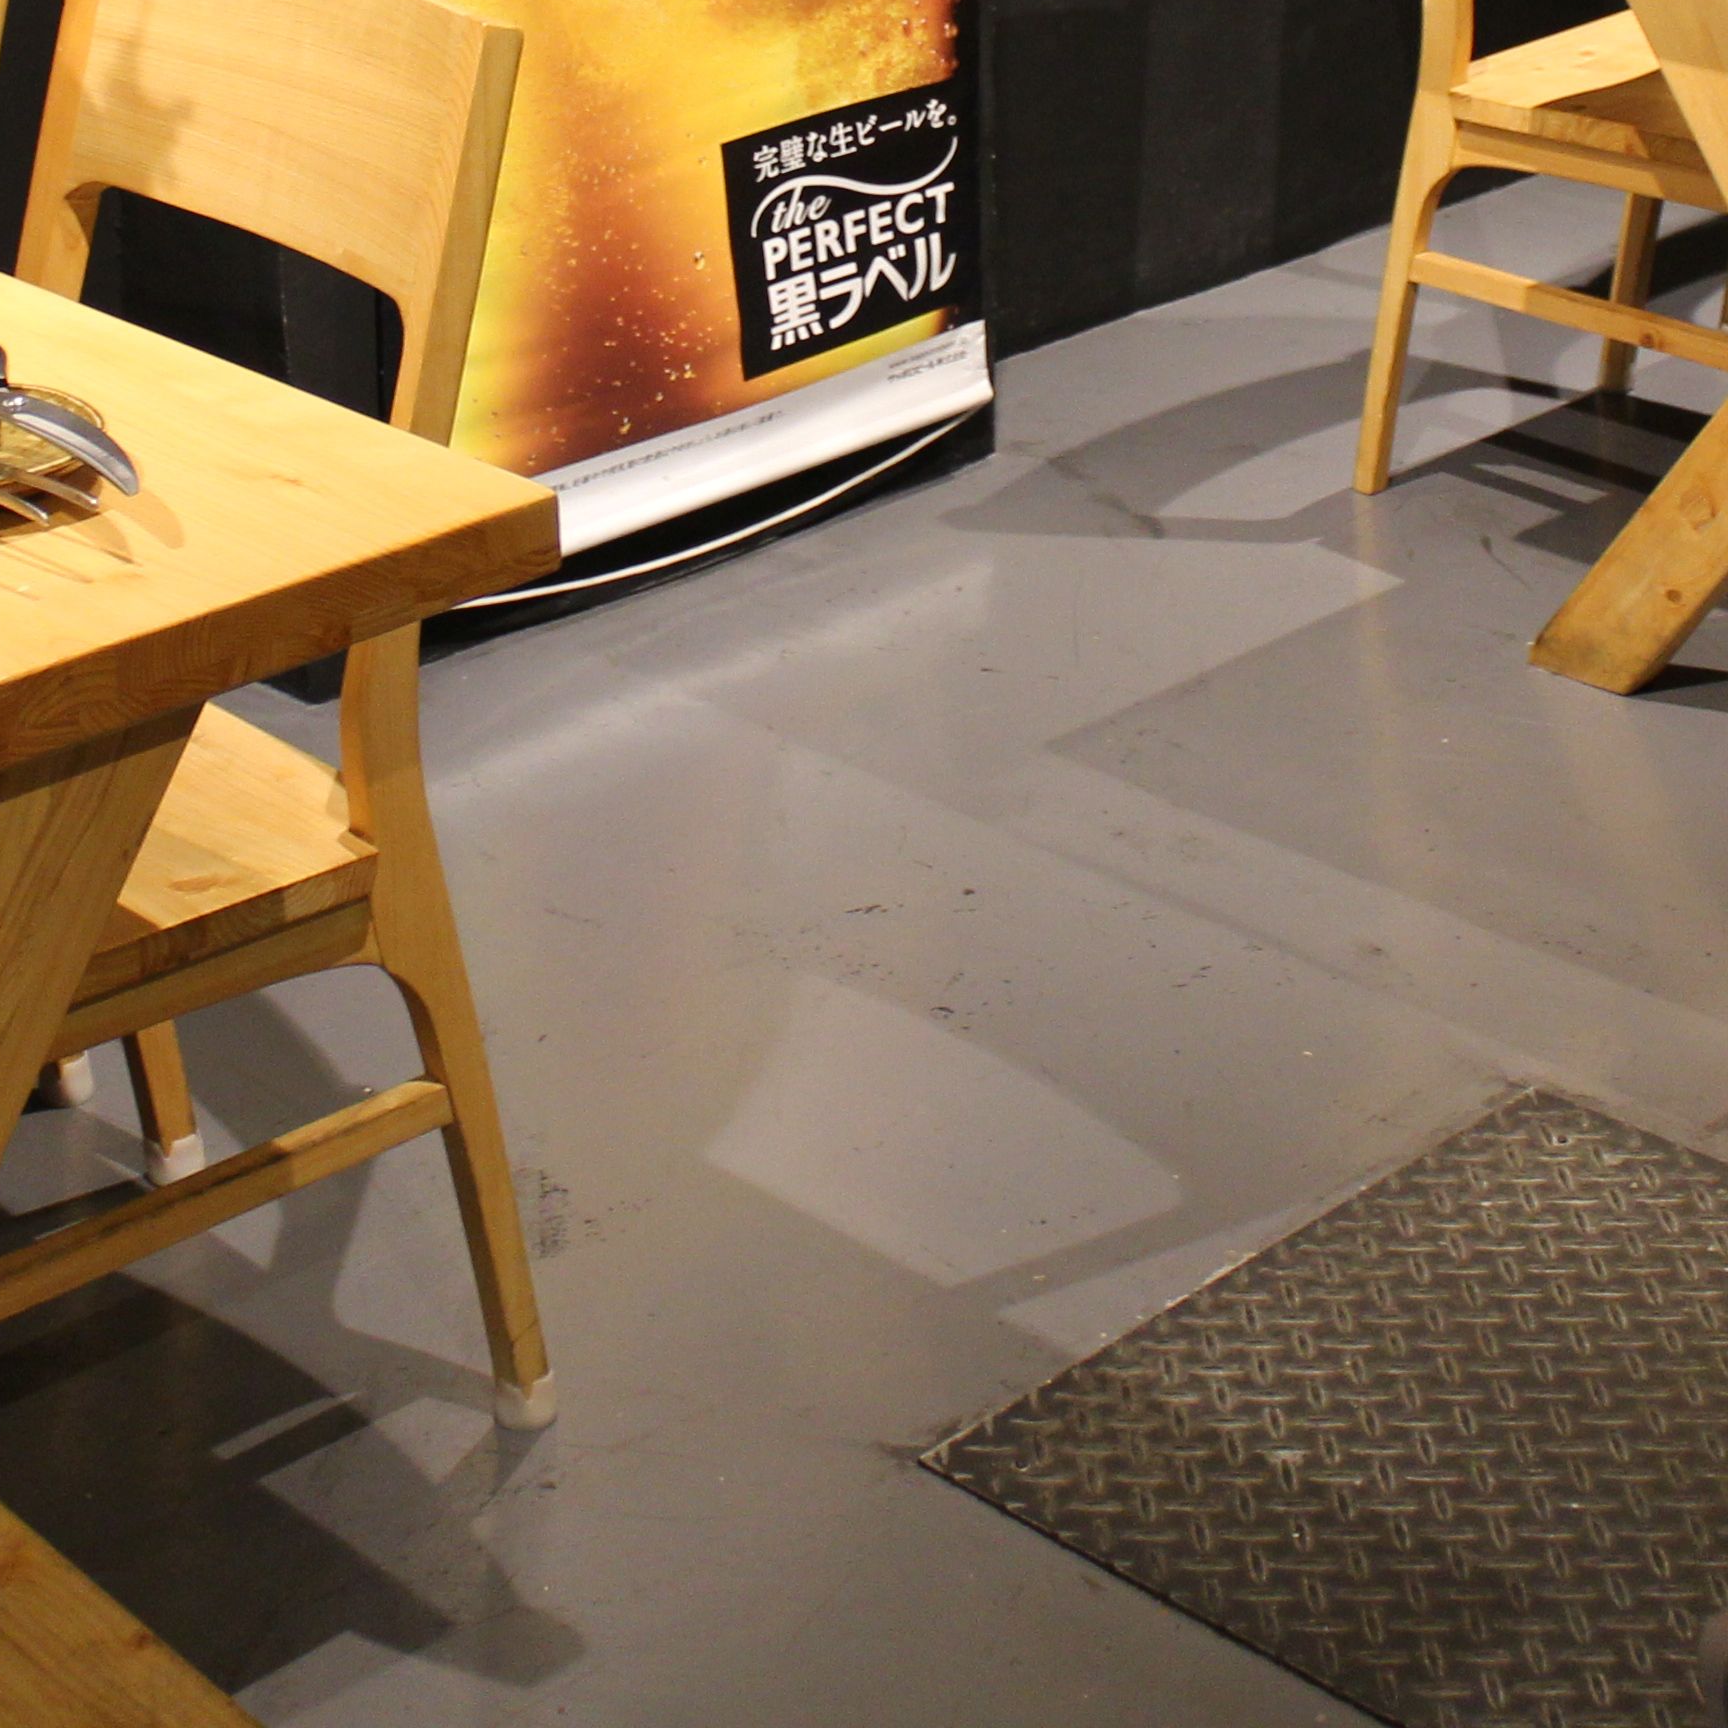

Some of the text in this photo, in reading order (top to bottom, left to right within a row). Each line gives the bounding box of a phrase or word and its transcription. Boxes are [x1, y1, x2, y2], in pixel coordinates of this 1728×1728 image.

[752, 98, 958, 183] 完璧な生ビールを。
[762, 181, 956, 281] PERFECT
[770, 185, 832, 234] the
[767, 231, 957, 351] 黒ラベル
